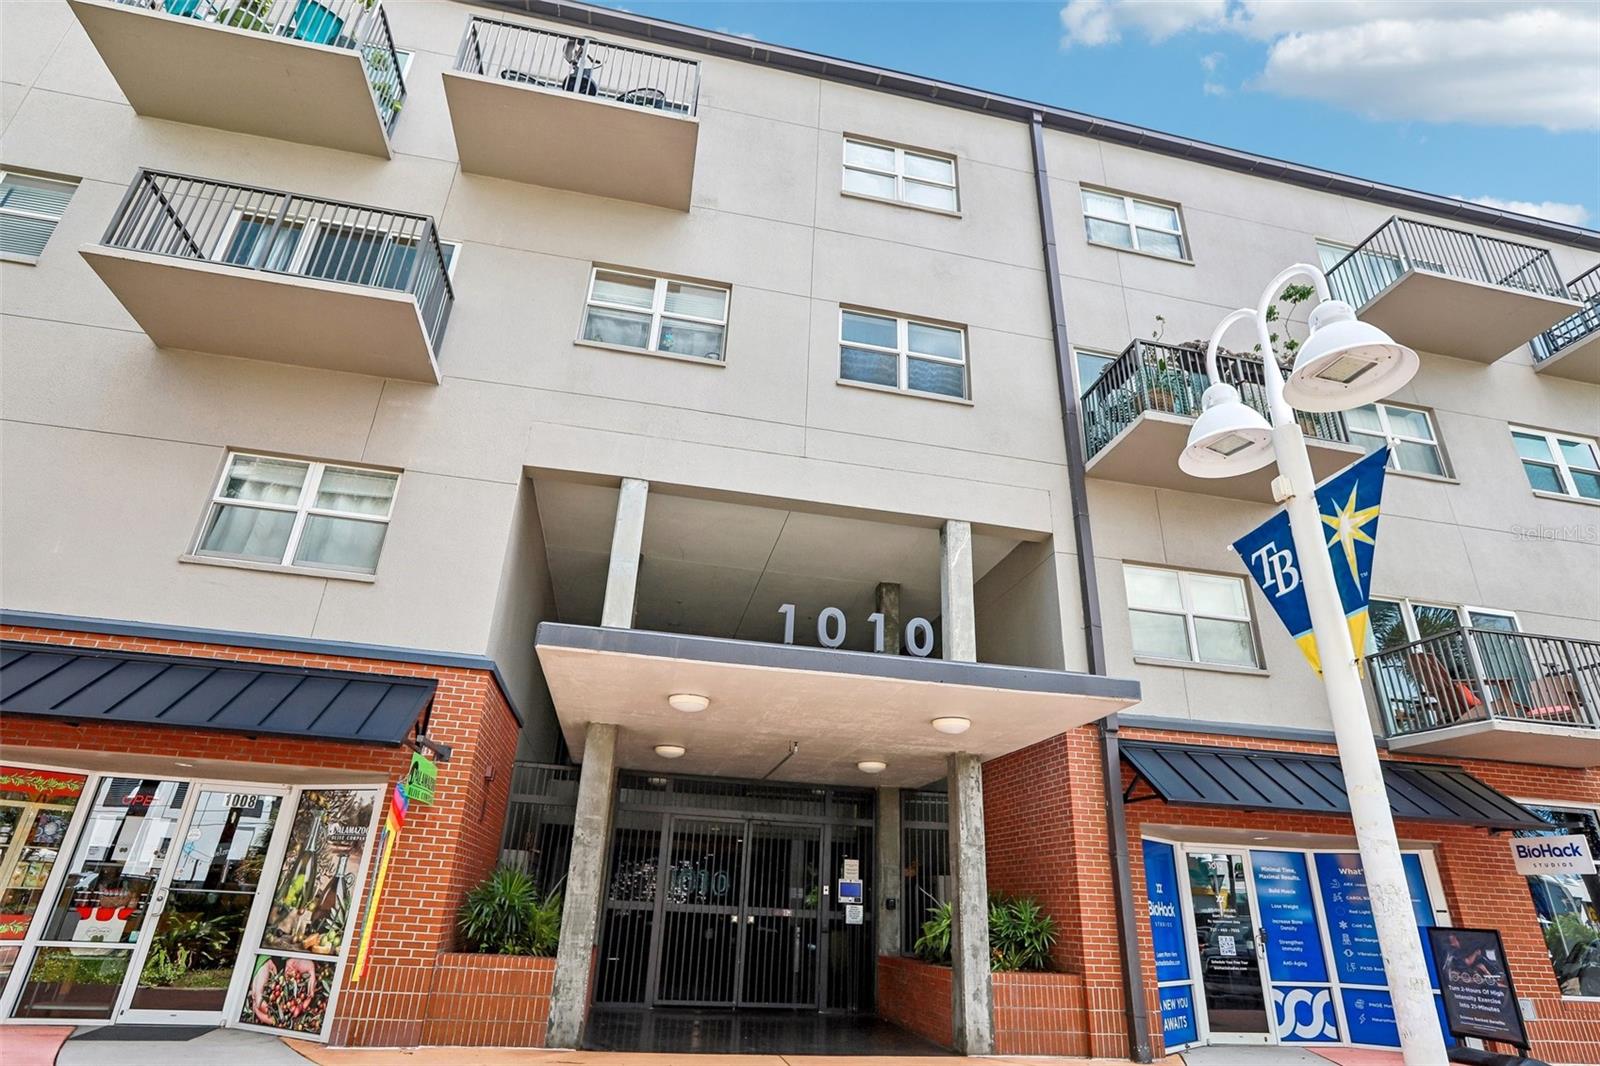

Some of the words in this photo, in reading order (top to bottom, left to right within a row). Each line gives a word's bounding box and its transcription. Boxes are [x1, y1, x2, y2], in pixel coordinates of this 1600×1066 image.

[1251, 541, 1300, 598] TB
[778, 603, 934, 657] 1010
[226, 794, 256, 808] 1008
[1516, 843, 1582, 858] BioHack
[1148, 900, 1175, 917] BioHack
[1454, 993, 1477, 1002] Intensity
[1478, 996, 1502, 1004] Exercise
[1490, 989, 1505, 997] High
[1162, 999, 1175, 1011] NEW
[1177, 998, 1188, 1009] YOU
[1164, 1016, 1188, 1031] AWAITS
